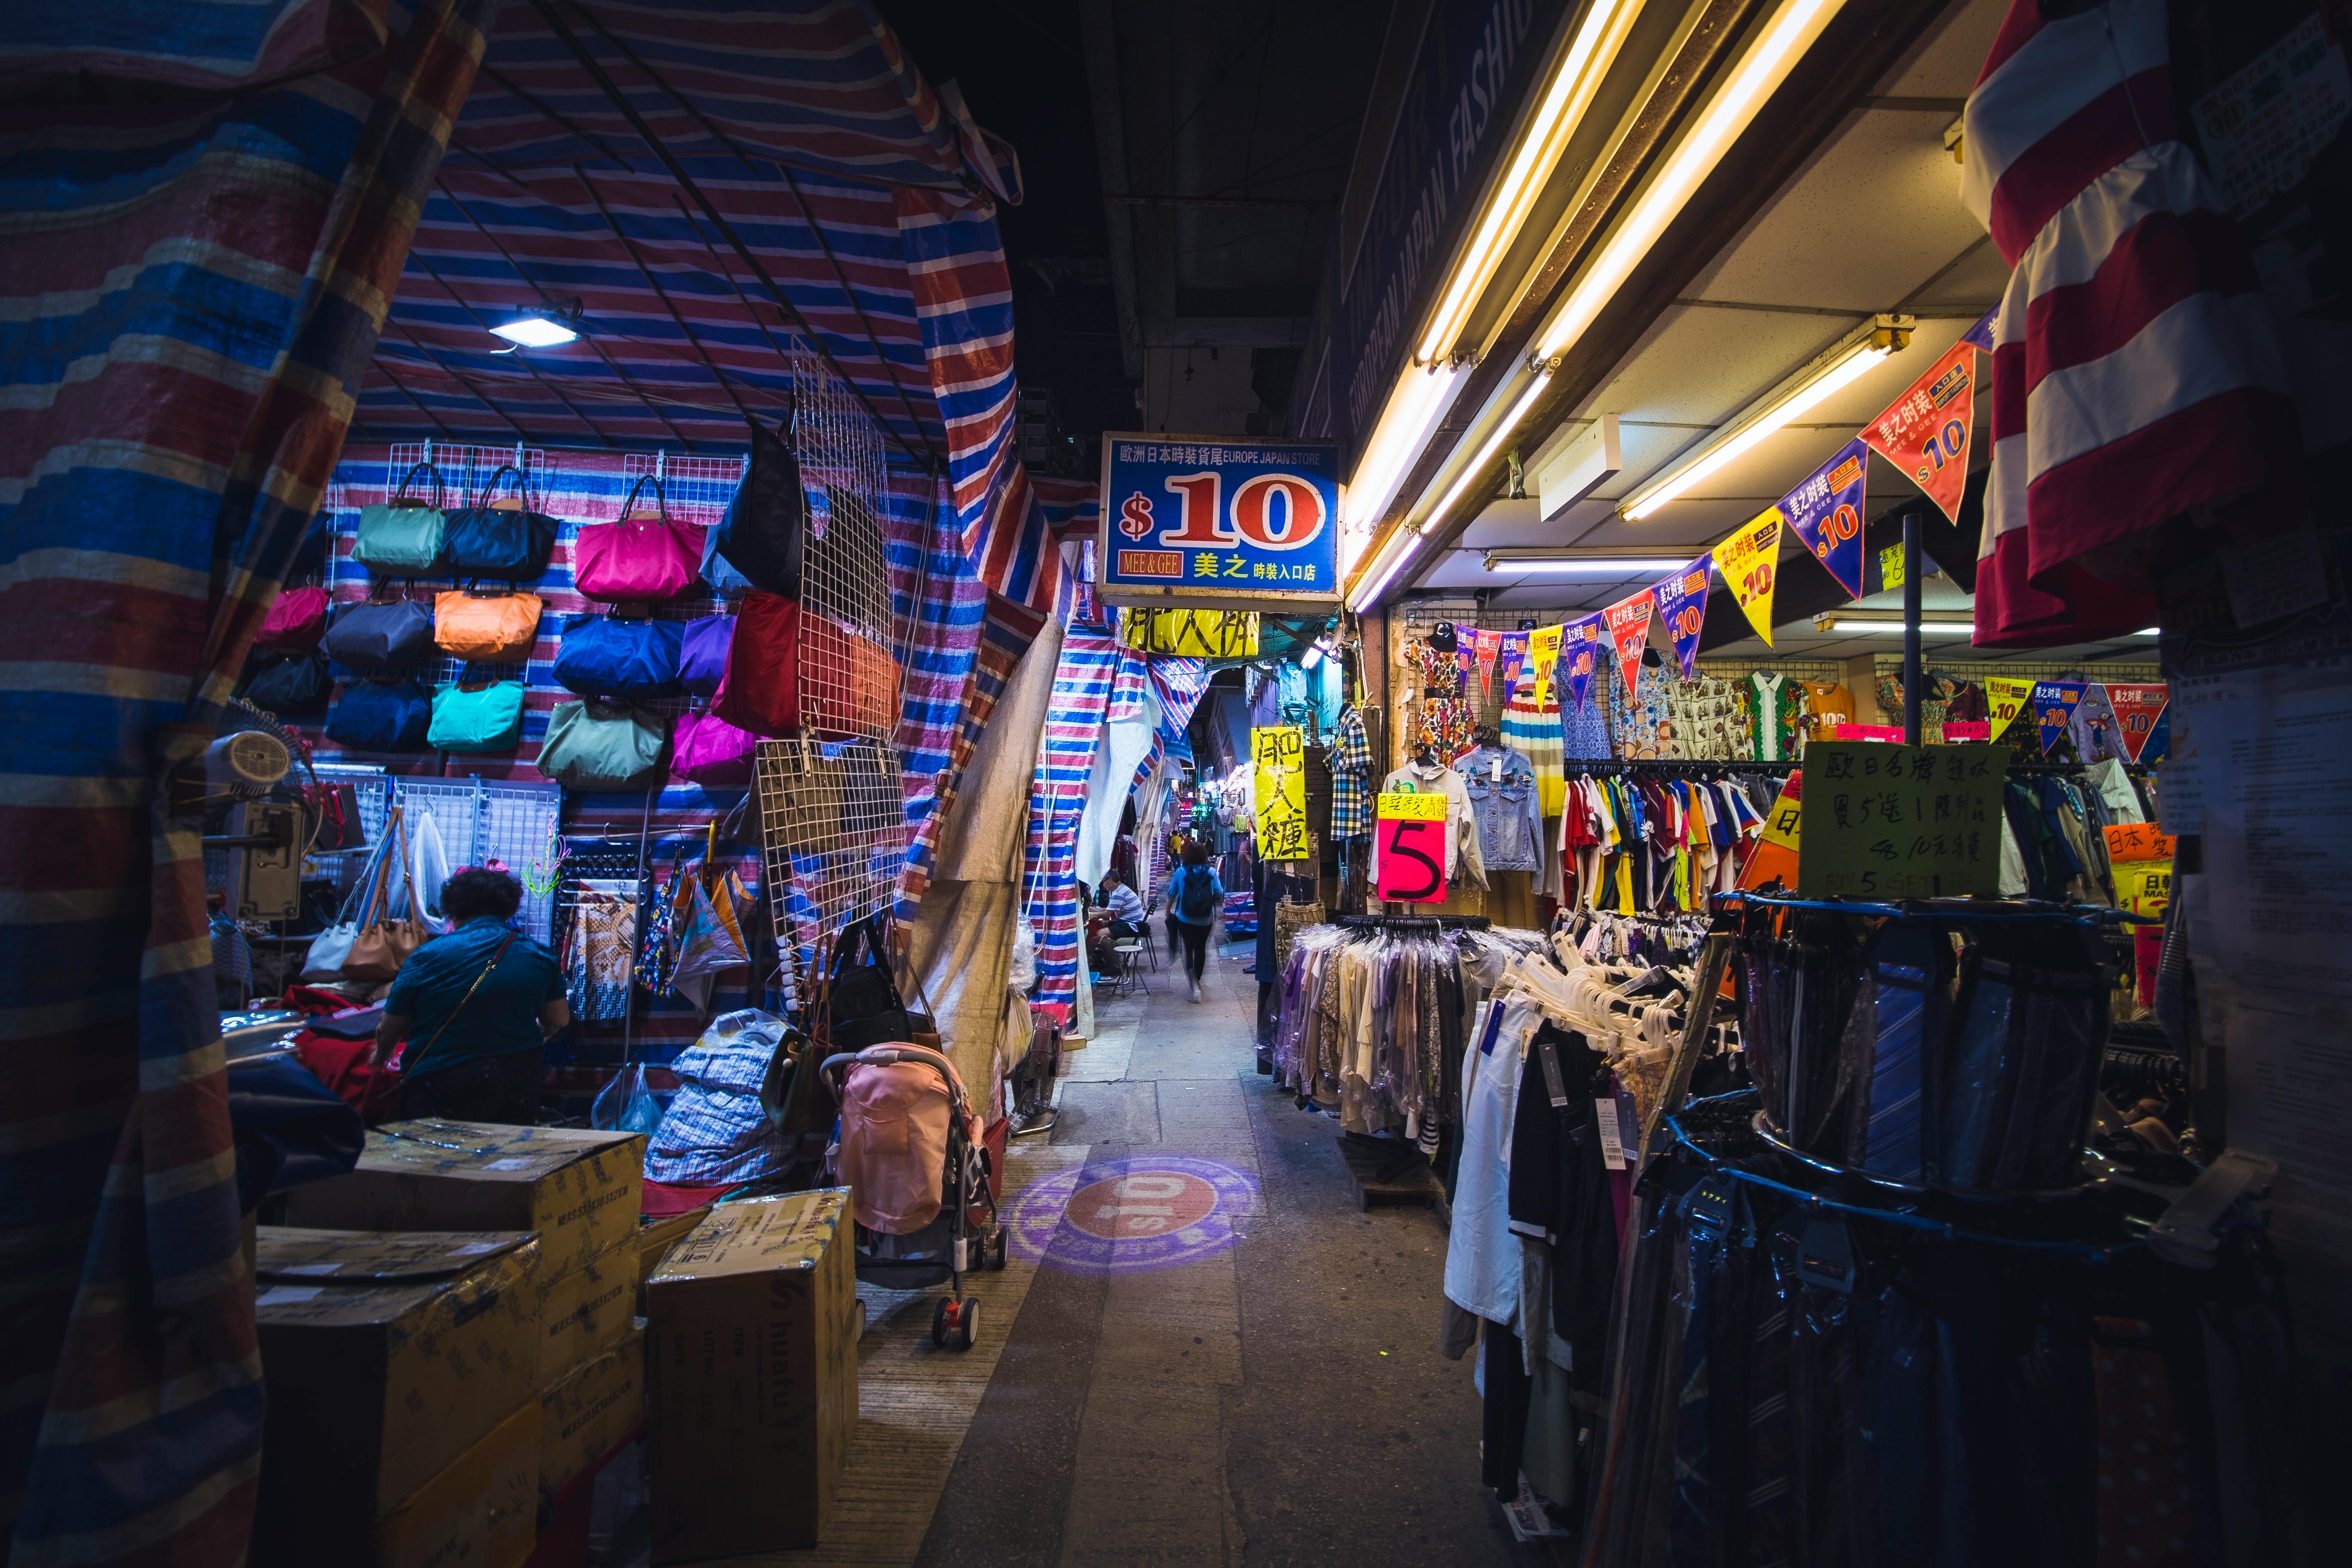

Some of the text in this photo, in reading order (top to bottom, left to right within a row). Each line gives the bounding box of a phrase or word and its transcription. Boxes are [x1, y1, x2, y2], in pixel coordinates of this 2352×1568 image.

[1349, 0, 1544, 437] EUROPEAN JAPAN FASHIO
[1935, 368, 1958, 393] 入口店
[1878, 389, 1933, 447] 美之时装
[1889, 413, 1937, 456] MEE & GEE
[1120, 445, 1223, 466] 歐洲日本時裝貨尾
[1224, 450, 1320, 466] EUROPE JAPAN STORE
[1917, 418, 1966, 484] $10
[1833, 461, 1853, 479] 入口店
[1789, 473, 1829, 521] 美之时装
[1119, 471, 1326, 551] $10
[1796, 497, 1831, 529] MEE & GEE
[1758, 524, 1774, 539] 入口店
[1817, 504, 1859, 558] $10
[1123, 553, 1178, 574] MEE & GEE
[1721, 533, 1755, 570] 美之时装
[1725, 570, 1736, 578] MEE
[1744, 555, 1757, 565] GEE
[1660, 576, 1685, 606] 美之时装
[1740, 564, 1772, 607] $10
[1612, 605, 1634, 629] 美之时装
[1662, 605, 1671, 614] MEE
[1676, 597, 1685, 605] GEE
[1566, 624, 1584, 644] 美之时装
[1672, 606, 1700, 643] $10
[1620, 634, 1643, 665] $10
[1504, 661, 1520, 682] $10
[1535, 659, 1552, 681] $10
[1571, 651, 1590, 677] $10
[1990, 681, 2011, 694] 美之时装
[2035, 686, 2061, 699] 美之时装
[2114, 689, 2141, 703] 美之时装
[1991, 703, 2016, 721] $10
[2039, 708, 2066, 727] $10
[2121, 713, 2149, 733] $10
[1254, 730, 1307, 859] 肥人褲
[1860, 870, 1878, 893] 5
[674, 1334, 685, 1368] DATE
[704, 1331, 715, 1355] LOT
[732, 1327, 744, 1358] ITEM
[770, 1320, 795, 1409] huafu
